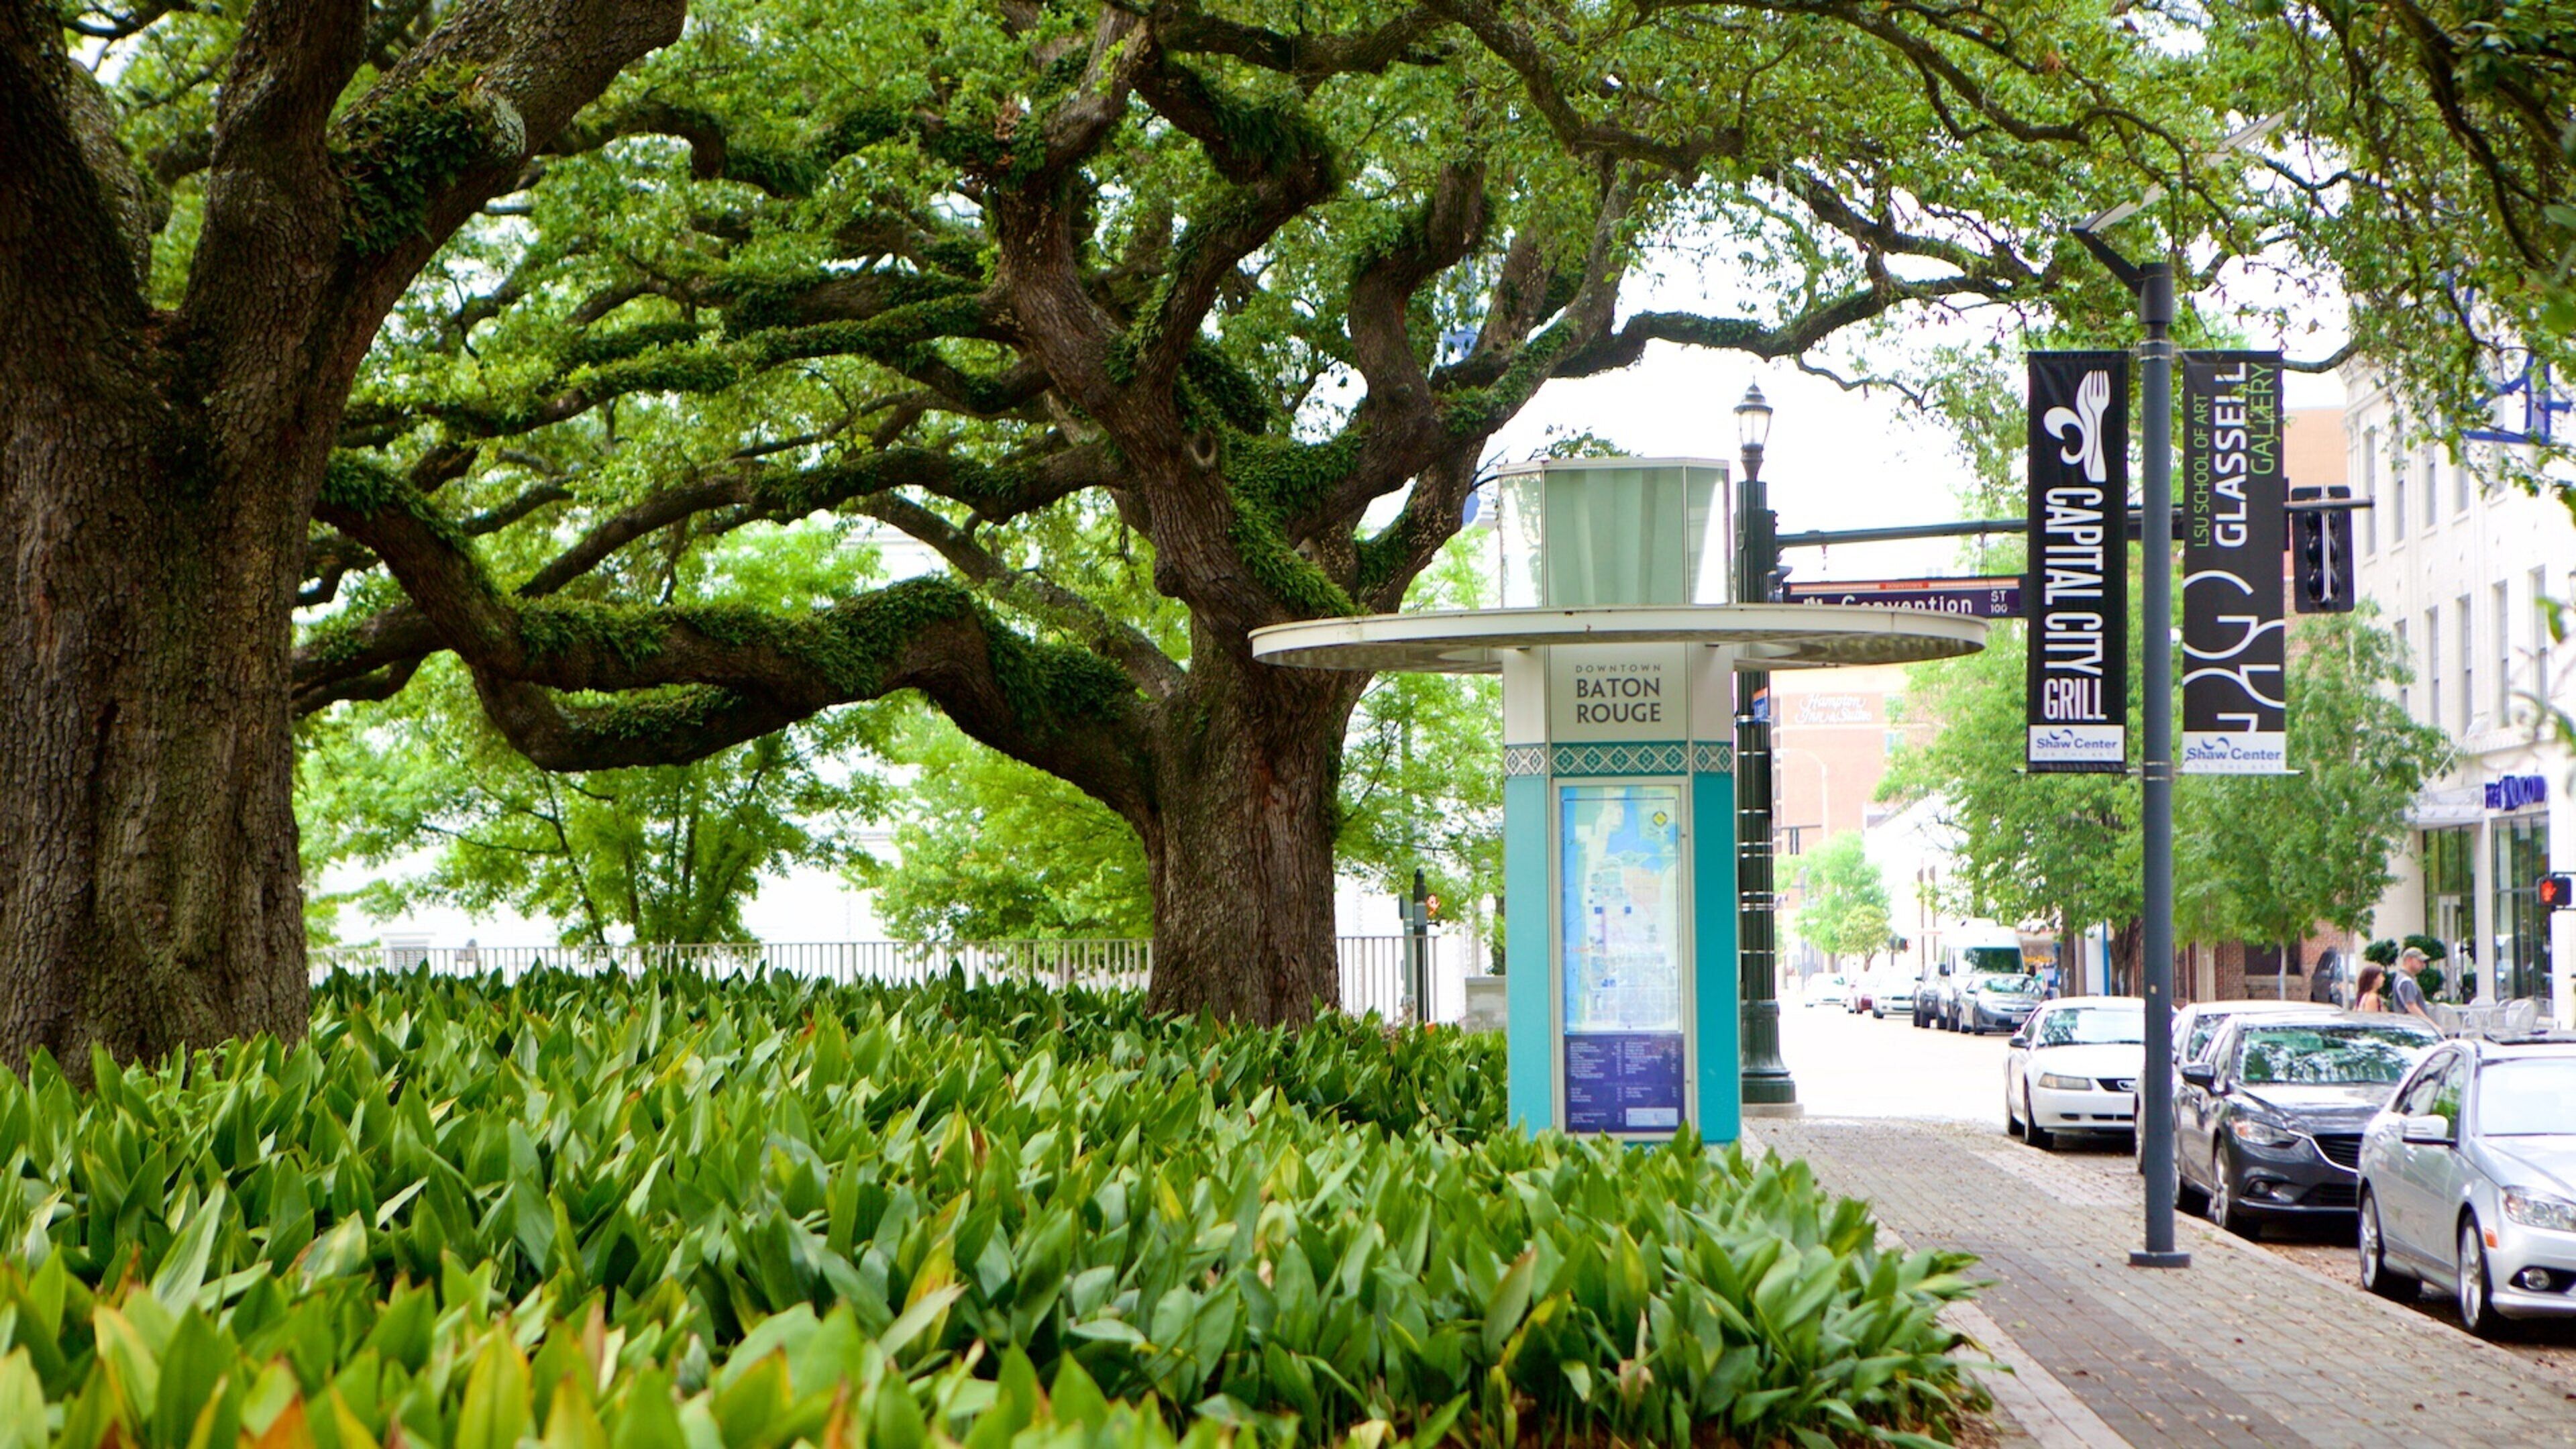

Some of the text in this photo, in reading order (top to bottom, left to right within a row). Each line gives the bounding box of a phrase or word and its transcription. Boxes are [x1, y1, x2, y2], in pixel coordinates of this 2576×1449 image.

[2215, 362, 2247, 547] GLASSELL
[2193, 392, 2209, 547] LSU SCHOOL OF ART
[2045, 487, 2103, 676] CAPITAL CITY
[1842, 595, 1972, 614] vention
[1990, 590, 2006, 602] ST
[1990, 604, 2008, 613] 100
[1576, 664, 1660, 672] DOWNTOWN
[1576, 677, 1660, 698] BATON
[2044, 678, 2106, 720] GRILL
[1576, 702, 1661, 723] ROUGE
[2037, 738, 2117, 749] Shaw Center
[2186, 747, 2281, 760] Shaw Center
